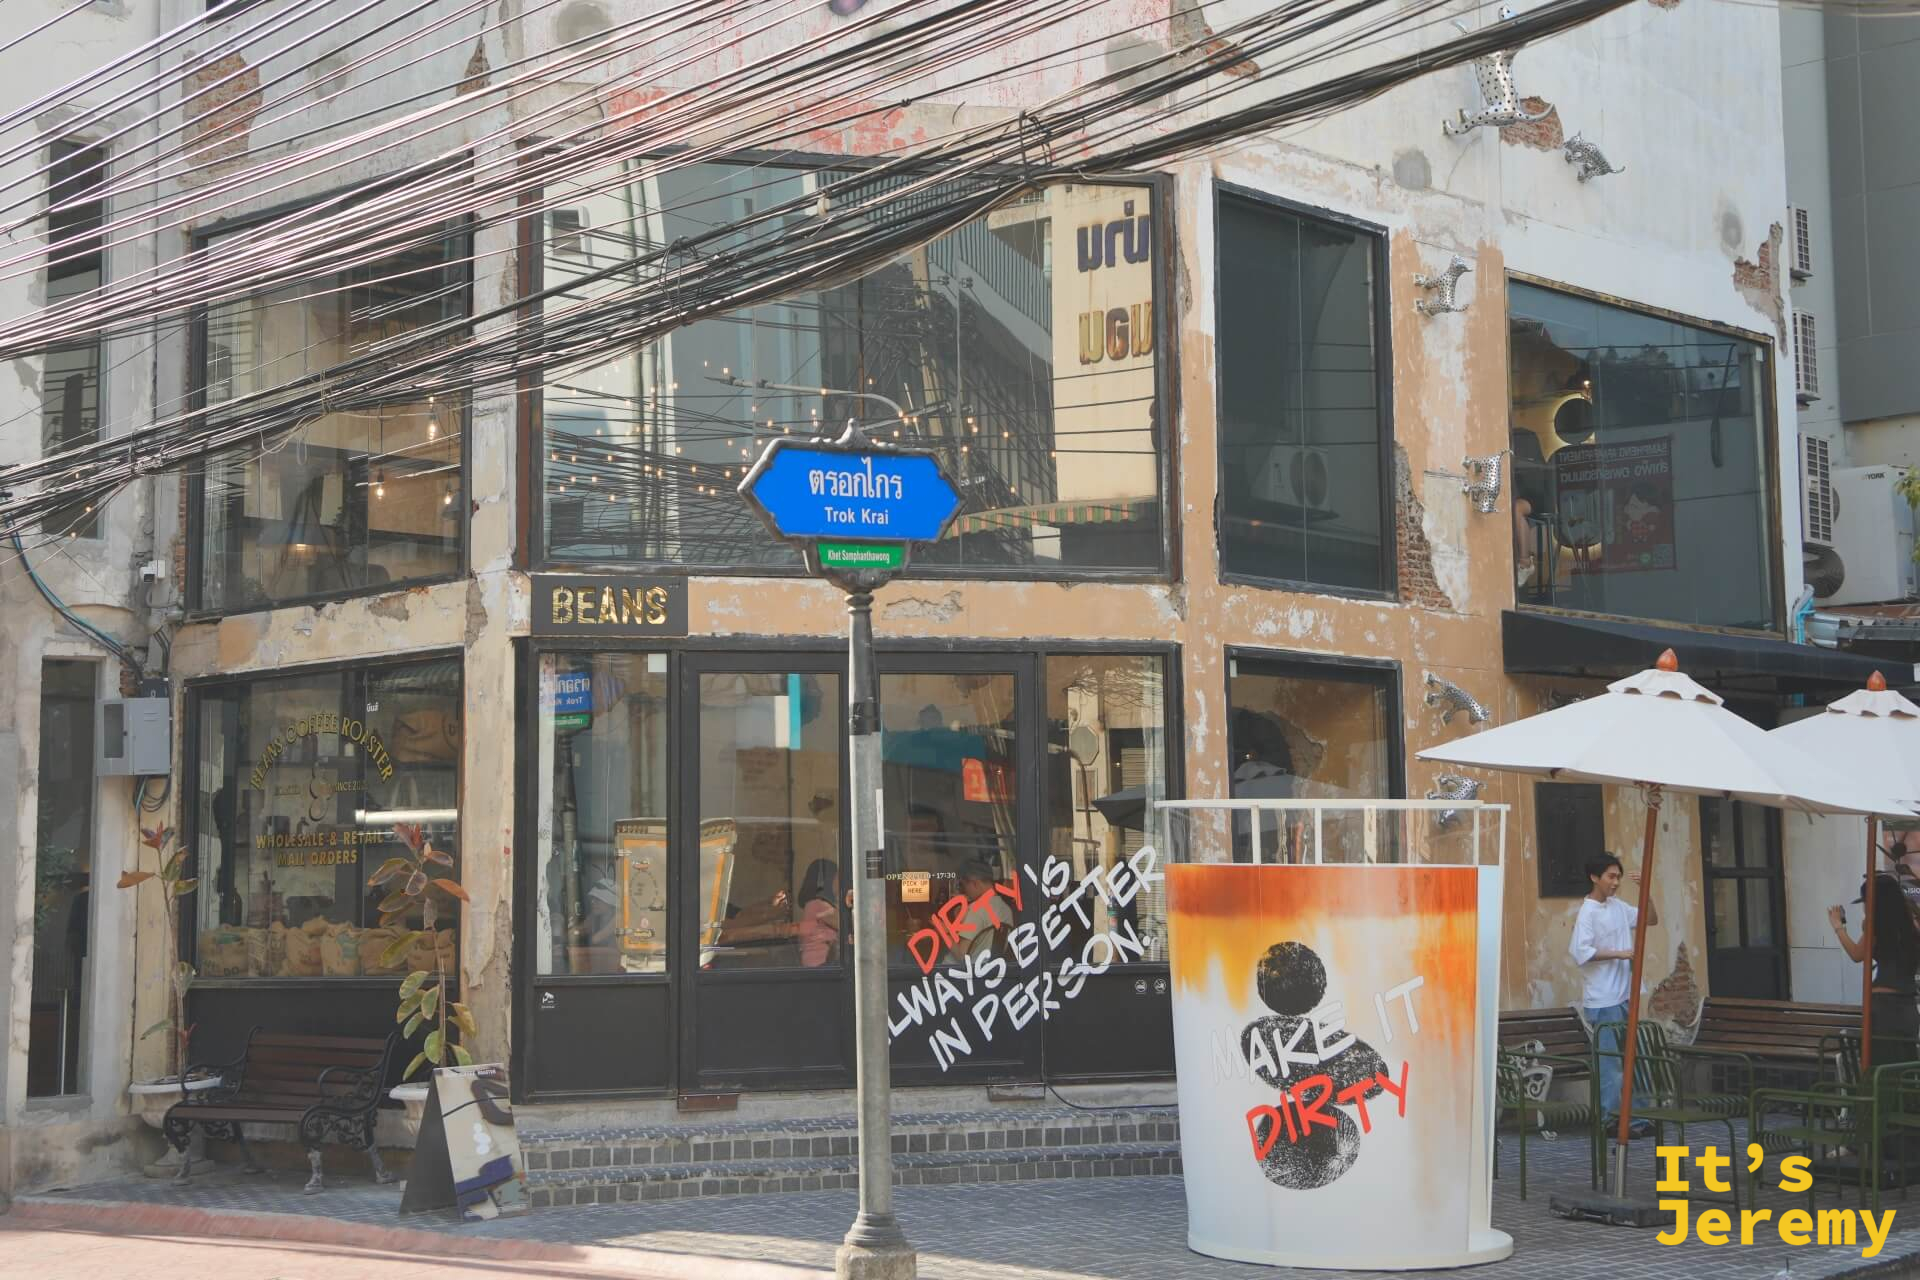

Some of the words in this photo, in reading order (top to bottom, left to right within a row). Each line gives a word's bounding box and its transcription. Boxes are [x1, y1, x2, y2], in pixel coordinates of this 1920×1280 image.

[808, 456, 903, 500] ตรอกไกร
[824, 506, 856, 524] Trok
[861, 508, 889, 525] Krai
[828, 549, 841, 561] Khet
[841, 550, 890, 564] Samphanthawong
[552, 585, 668, 625] BEANS
[250, 737, 283, 791] BEANS
[286, 714, 338, 743] COFFEE
[341, 717, 393, 783] ROASTER
[256, 832, 325, 849] WHOLESALE
[329, 831, 337, 847] &
[343, 830, 385, 845] RETAIL
[277, 851, 304, 867] MAIL
[311, 850, 358, 866] ORDERS
[888, 948, 1006, 1045] LWAYS
[1008, 845, 1165, 970] BETTER
[907, 869, 1023, 975] DIRTY
[928, 1018, 972, 1072] IN
[972, 920, 1152, 1041] PERSON.
[1210, 1001, 1355, 1085] MAKE
[1374, 976, 1424, 1043] IT
[1245, 1060, 1409, 1162] DIRTY
